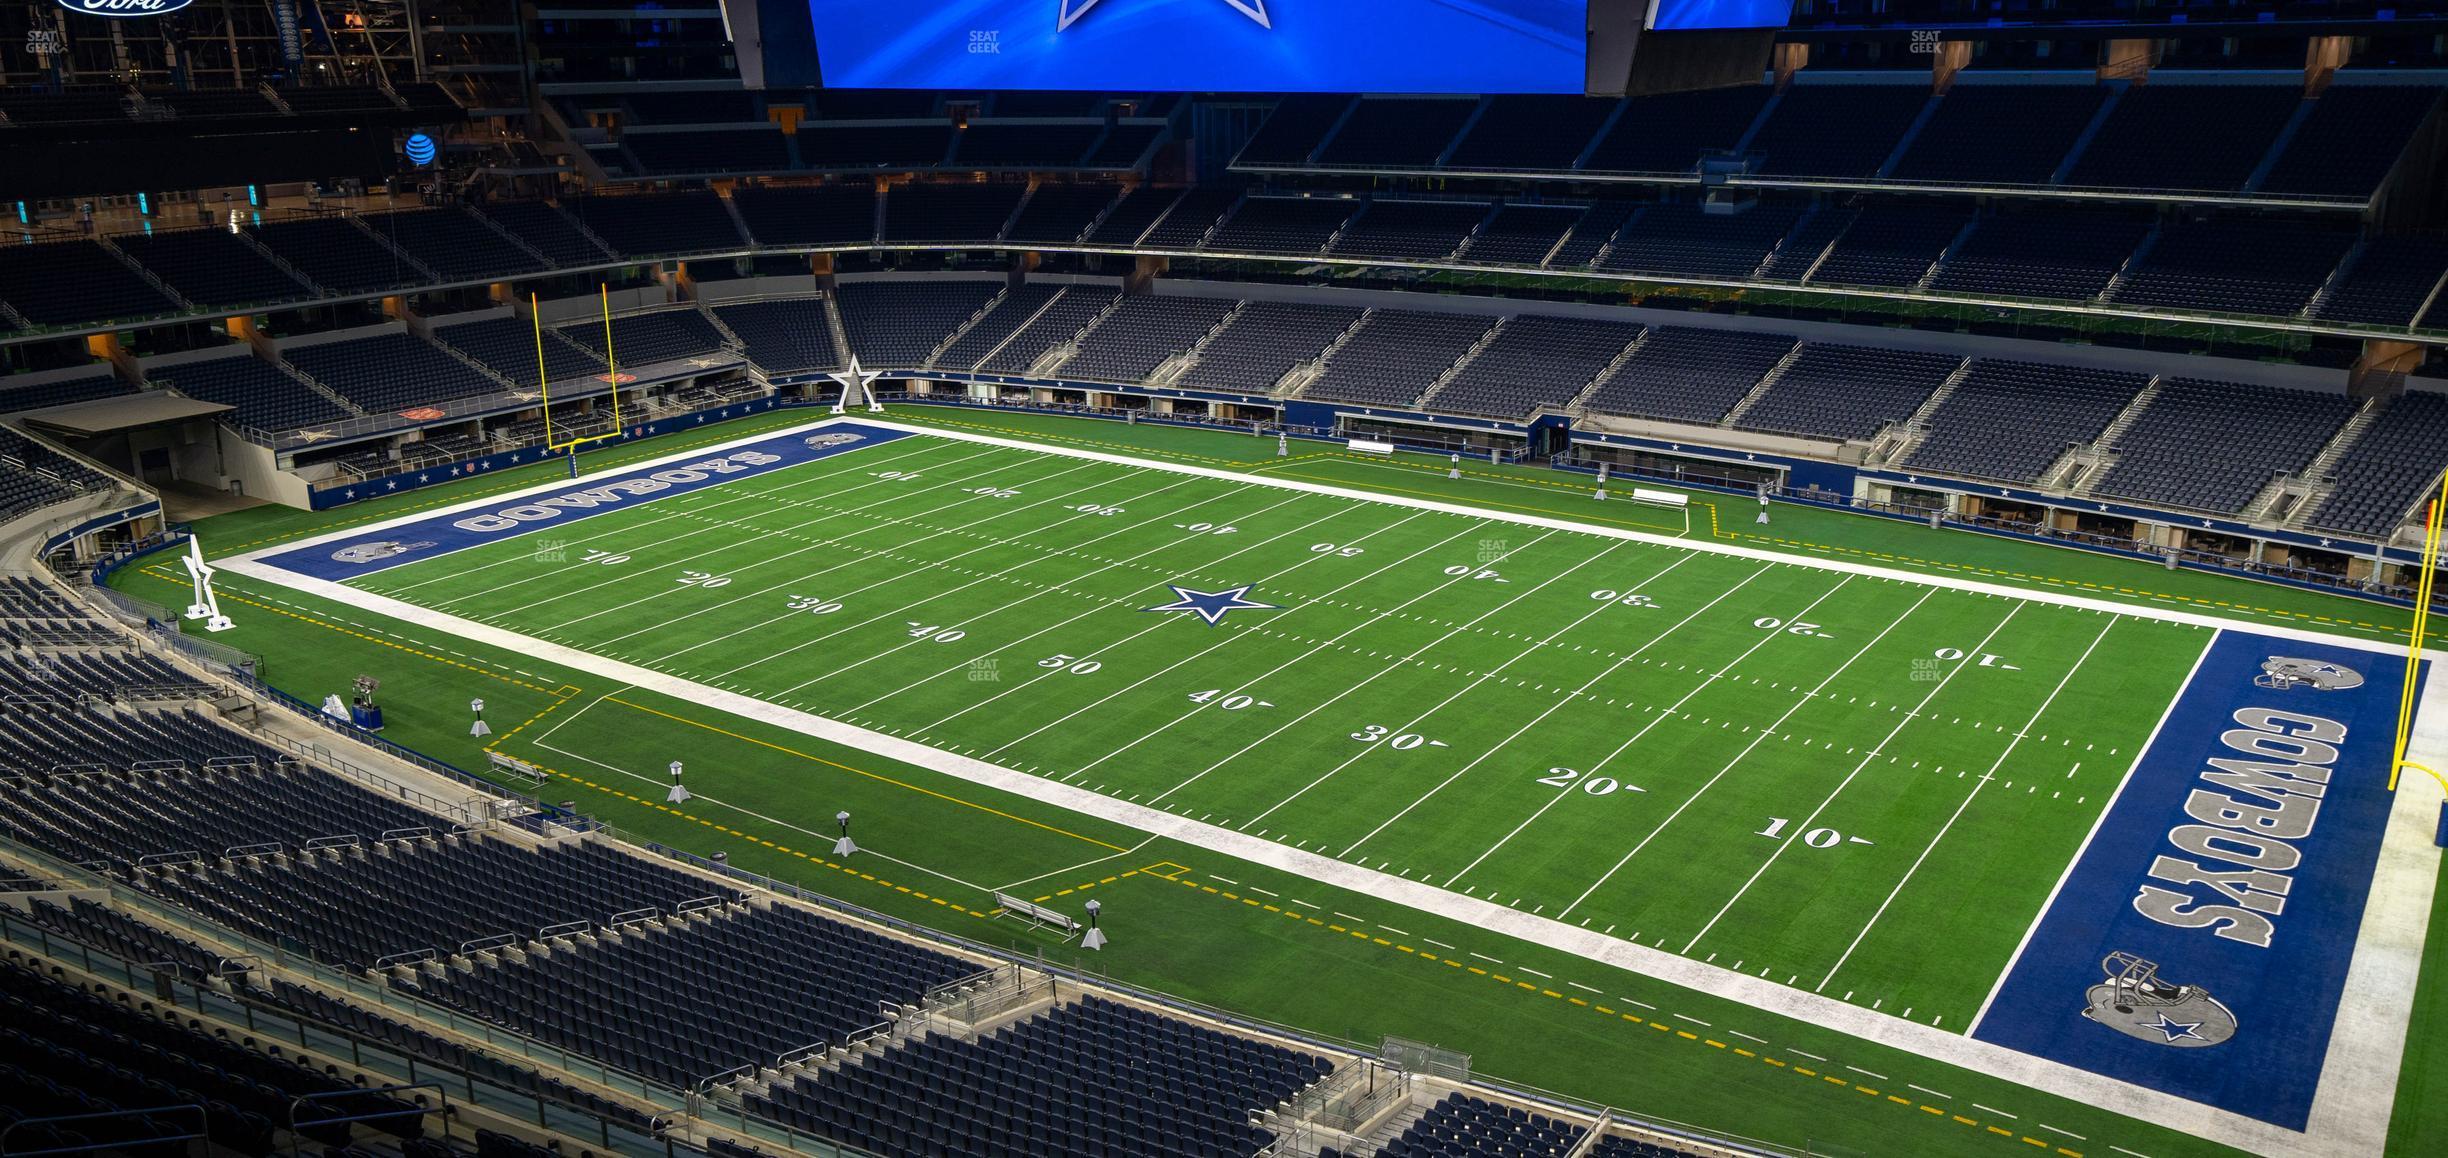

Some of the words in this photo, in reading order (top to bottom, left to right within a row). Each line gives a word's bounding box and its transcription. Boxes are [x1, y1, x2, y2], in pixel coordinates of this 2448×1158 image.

[83, 0, 166, 10] or
[453, 451, 781, 532] COWBOYS
[1188, 522, 1237, 535] 40
[579, 551, 631, 565] 10
[1310, 543, 1365, 557] 50
[675, 572, 732, 588] 20
[1443, 565, 1500, 580] 40
[787, 597, 843, 615] 30
[1589, 589, 1652, 606] 30
[907, 625, 966, 643] 40
[1753, 617, 1822, 635] 20
[1038, 653, 1102, 675] 50
[1934, 647, 2004, 667] 10
[1187, 689, 1254, 710] 40
[1350, 725, 1425, 750] 30
[1536, 767, 1619, 796] 20
[1754, 816, 1842, 849] 10
[2132, 707, 2348, 948] COWBOYS
